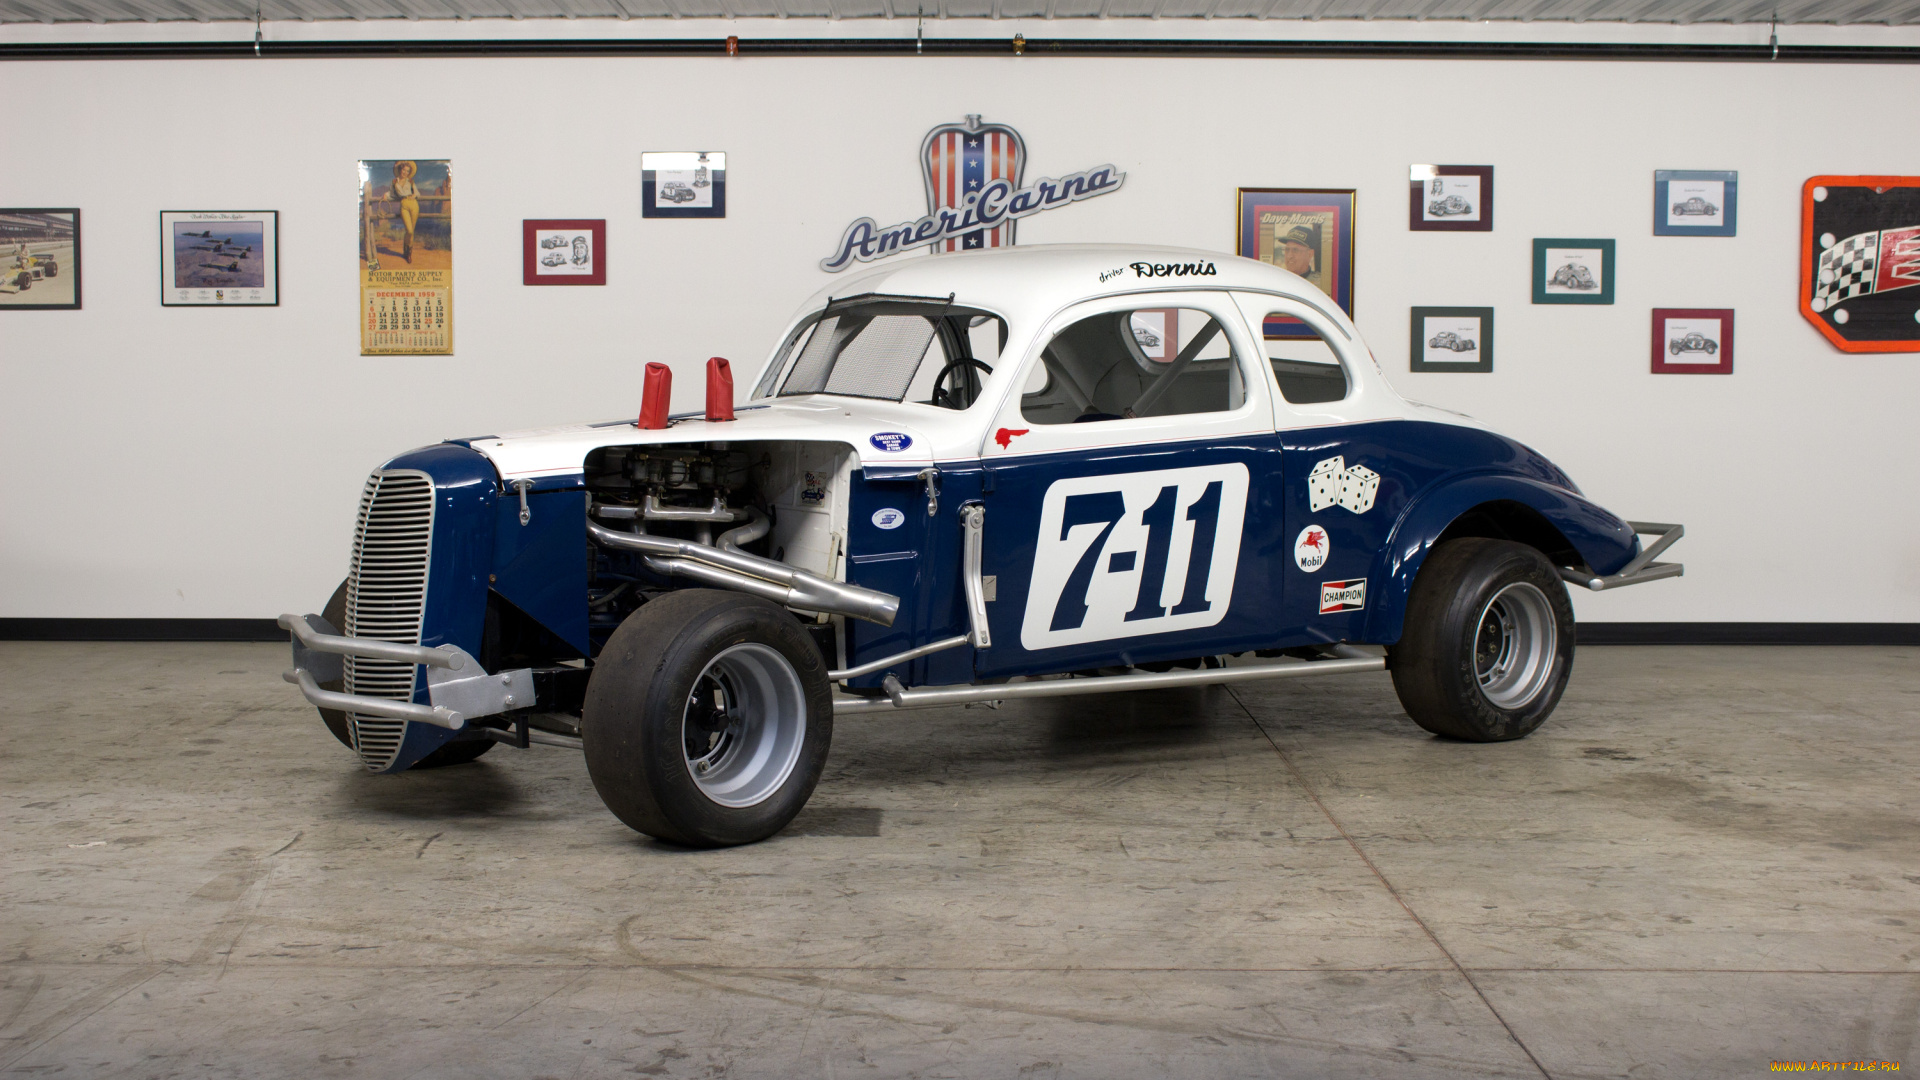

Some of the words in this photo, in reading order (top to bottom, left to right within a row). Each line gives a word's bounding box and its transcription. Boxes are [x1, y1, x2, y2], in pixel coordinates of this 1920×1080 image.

[826, 167, 1118, 268] AmeriCarna
[1261, 213, 1288, 224] Dave
[1290, 213, 1325, 224] Marcis
[1129, 260, 1217, 278] Dennis
[1049, 480, 1223, 632] 7-11
[1301, 556, 1322, 567] Mobil
[1324, 589, 1362, 603] CHAMPION
